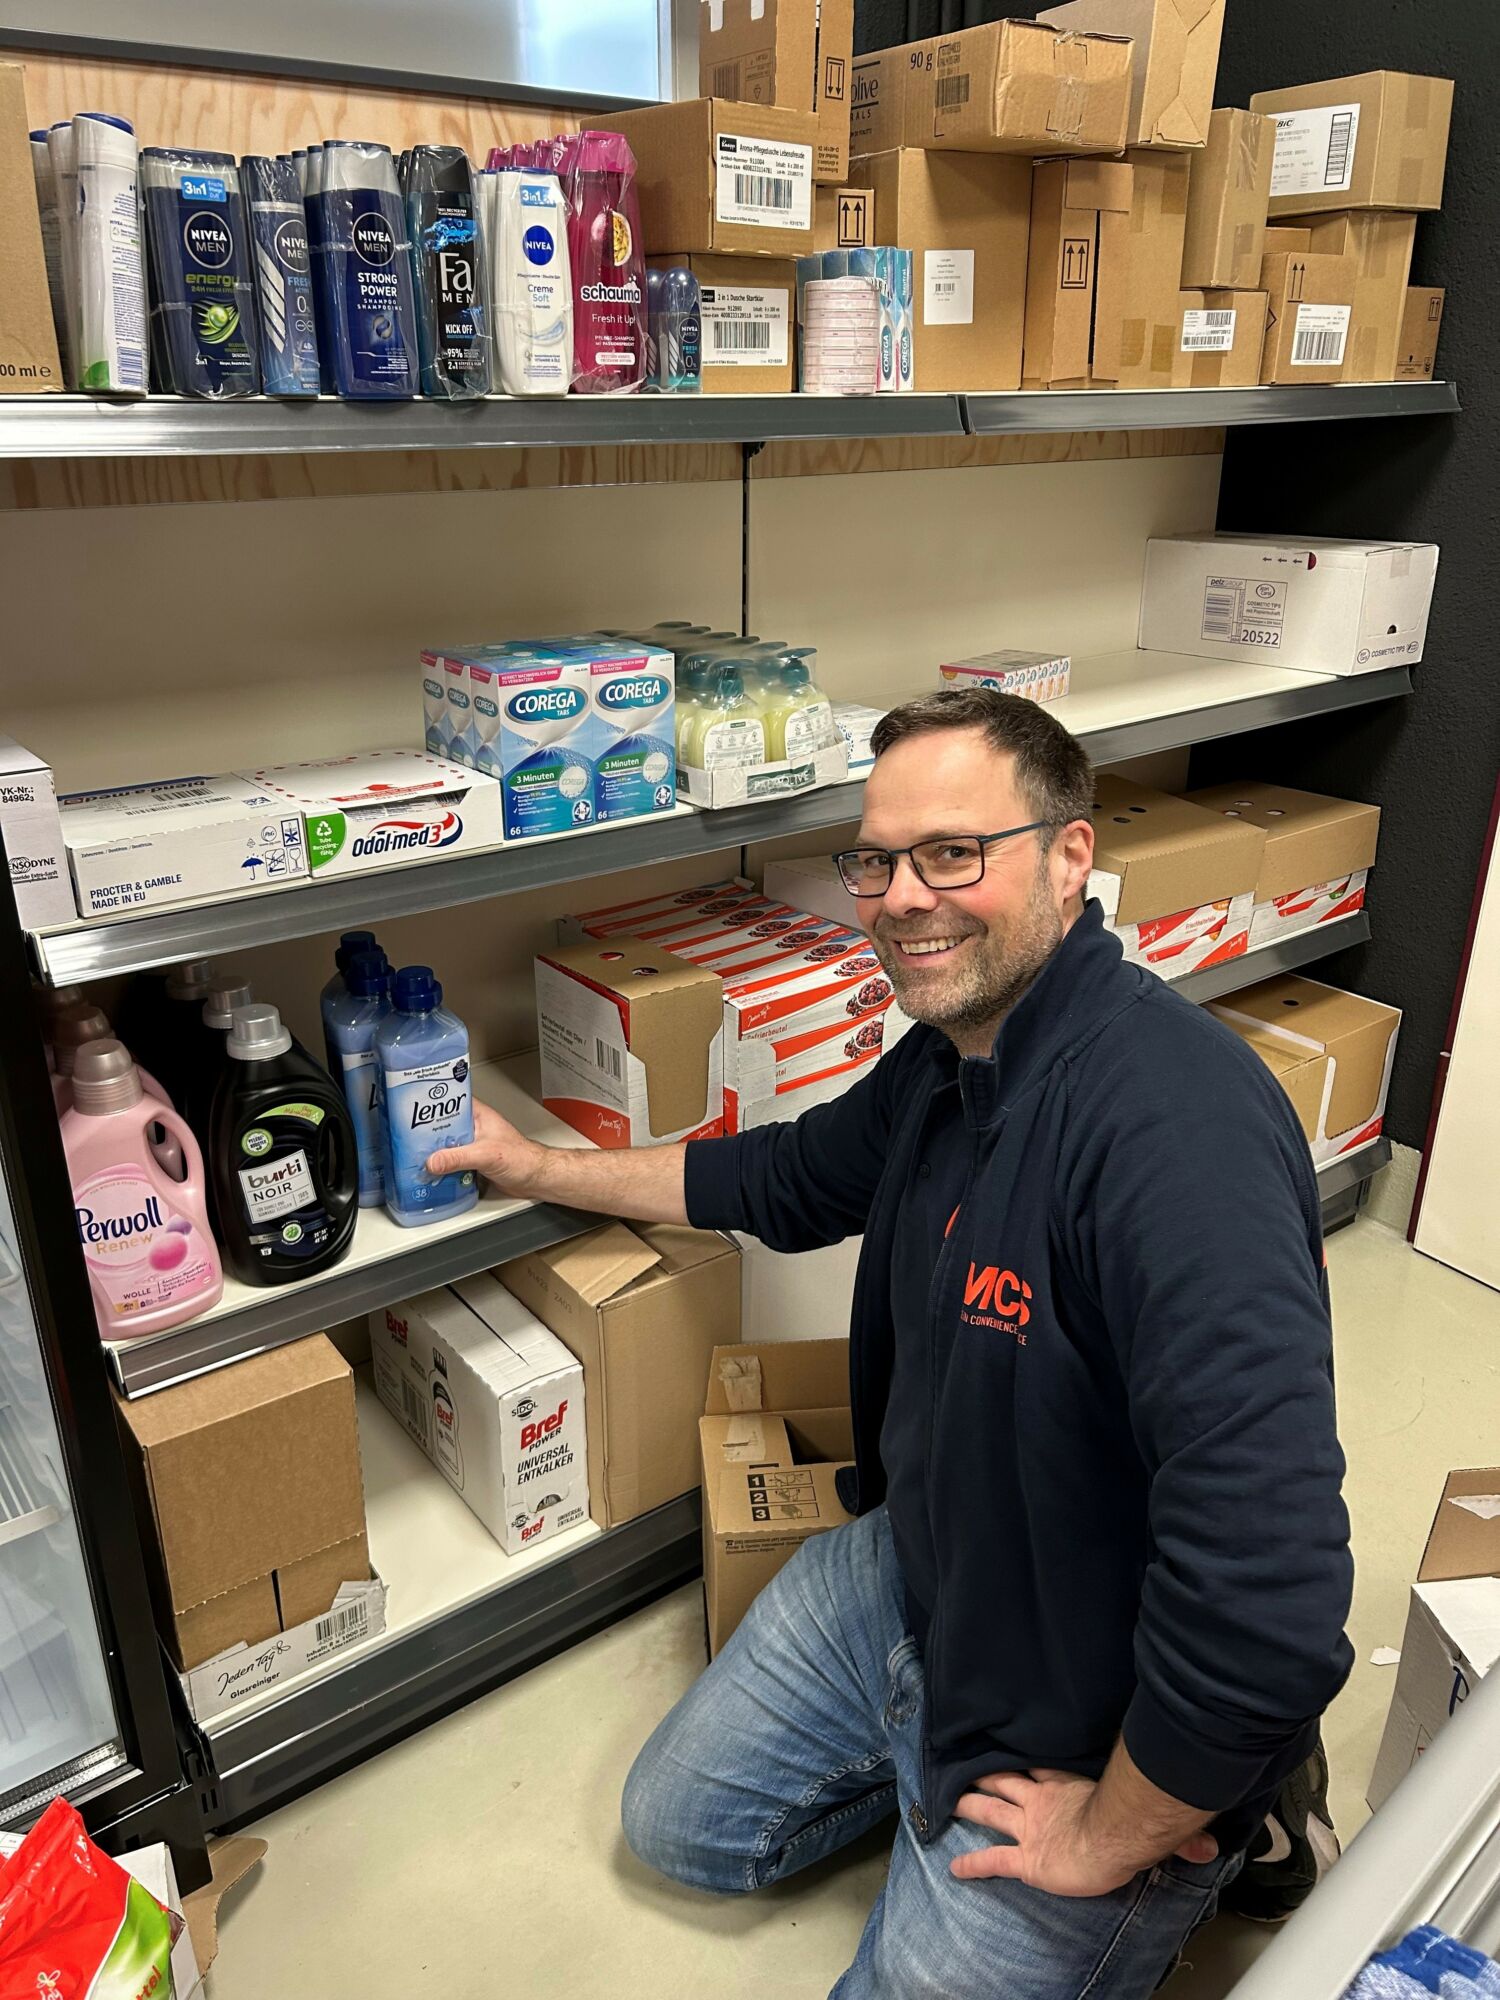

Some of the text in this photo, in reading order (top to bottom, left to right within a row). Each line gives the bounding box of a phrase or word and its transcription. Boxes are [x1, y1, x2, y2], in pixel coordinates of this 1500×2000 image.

[911, 51, 932, 71] 90 g
[184, 182, 207, 195] 3in1
[191, 229, 227, 242] NIVEA
[358, 231, 391, 243] NIVEA
[196, 242, 225, 253] MEN
[364, 243, 388, 252] MEN
[525, 240, 551, 251] NIVEA
[439, 252, 473, 291] Fa
[186, 273, 239, 287] energy
[358, 272, 397, 285] STRONG
[361, 285, 397, 297] POWER
[528, 284, 553, 294] Creme
[582, 284, 640, 302] schauma
[442, 293, 474, 304] MEN
[533, 294, 549, 302] Soft
[357, 303, 402, 311] SHAMPOOING
[592, 313, 615, 323] Fresh
[617, 314, 623, 323] it
[445, 324, 473, 335] KICK OFF
[447, 348, 463, 359] 95%
[20, 365, 37, 377] ml
[1247, 600, 1271, 608] COSMETIC
[1242, 629, 1279, 646] 20522
[1371, 647, 1396, 658] COSMETIC
[425, 681, 441, 694] COREGA
[606, 680, 660, 702] COREGA
[449, 689, 467, 704] COREGA
[515, 691, 577, 714] COREGA
[475, 697, 495, 713] COREGA
[557, 708, 570, 716] TABS
[611, 758, 639, 768] Minuten
[516, 772, 555, 784] 3 Minuten
[0, 786, 34, 795] VK-Nr.:
[598, 811, 607, 820] 66
[510, 826, 521, 836] 66
[90, 874, 183, 899] PROCTER & GAMBLE
[92, 892, 146, 910] MADE IN EU
[411, 1093, 466, 1129] Lenor
[248, 1158, 302, 1189] burti
[253, 1182, 292, 1202] NOIR
[416, 1188, 427, 1198] 38
[75, 1196, 163, 1244] Perwoll
[96, 1233, 153, 1255] Renew
[123, 1288, 151, 1299] WOLLE
[385, 1309, 408, 1341] Bref
[970, 1315, 1018, 1335] CONVENIENCE
[437, 1402, 454, 1426] Bref
[512, 1402, 538, 1417] SIDOL
[521, 1398, 568, 1450] Bref
[529, 1427, 562, 1453] POWER
[517, 1442, 570, 1473] UNIVERSAL
[517, 1453, 573, 1485] ENTKALKER
[752, 1476, 760, 1486] 1
[753, 1492, 764, 1502] 2
[557, 1506, 582, 1522] UNIVERSAL
[557, 1511, 584, 1527] ENTKALKER
[756, 1508, 767, 1519] 3
[512, 1516, 530, 1528] SIDOL
[521, 1515, 545, 1541] Bref
[218, 1649, 276, 1696] Jeden Tag
[230, 1672, 280, 1699] Glasreiniger
